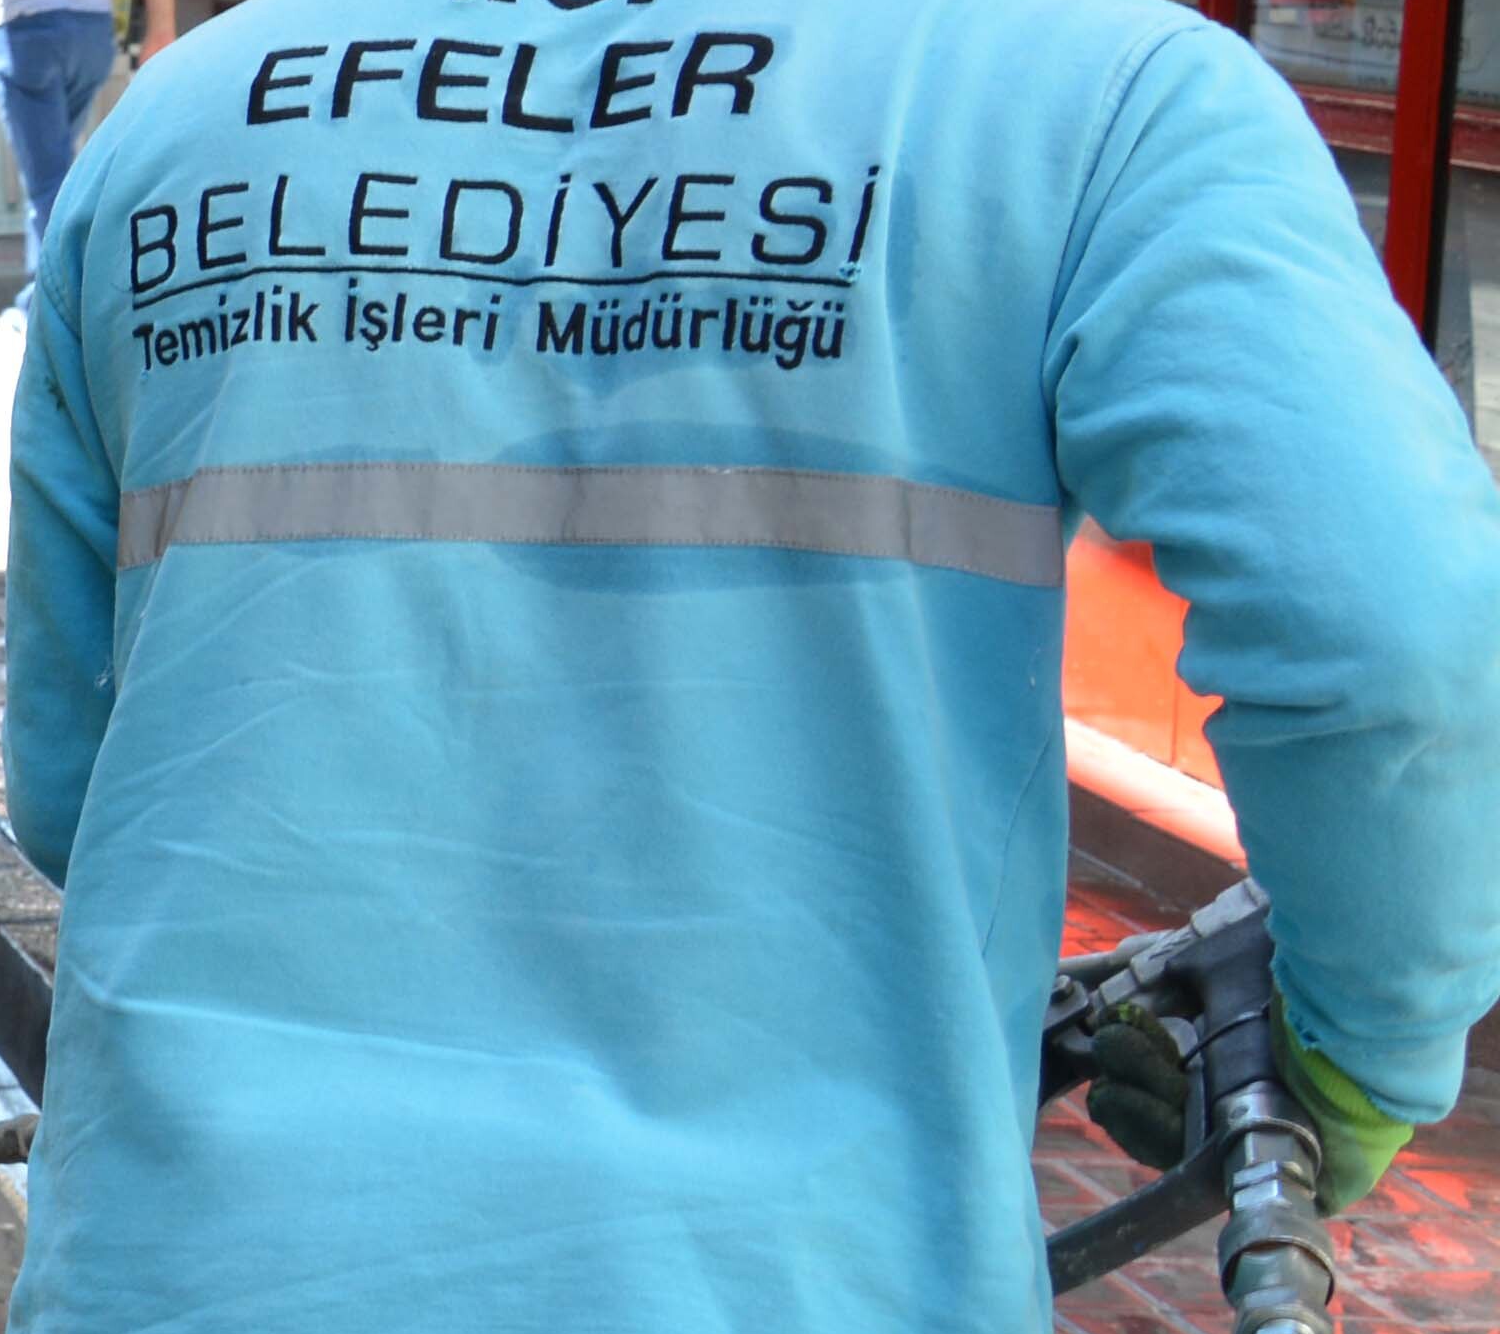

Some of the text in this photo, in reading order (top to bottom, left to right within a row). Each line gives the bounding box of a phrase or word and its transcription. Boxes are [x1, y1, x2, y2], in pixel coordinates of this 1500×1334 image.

[247, 32, 775, 133] EFELER
[130, 165, 881, 293] BELEDİYESİ
[132, 278, 847, 372] Temizlik İşleri Müdürlüğü
